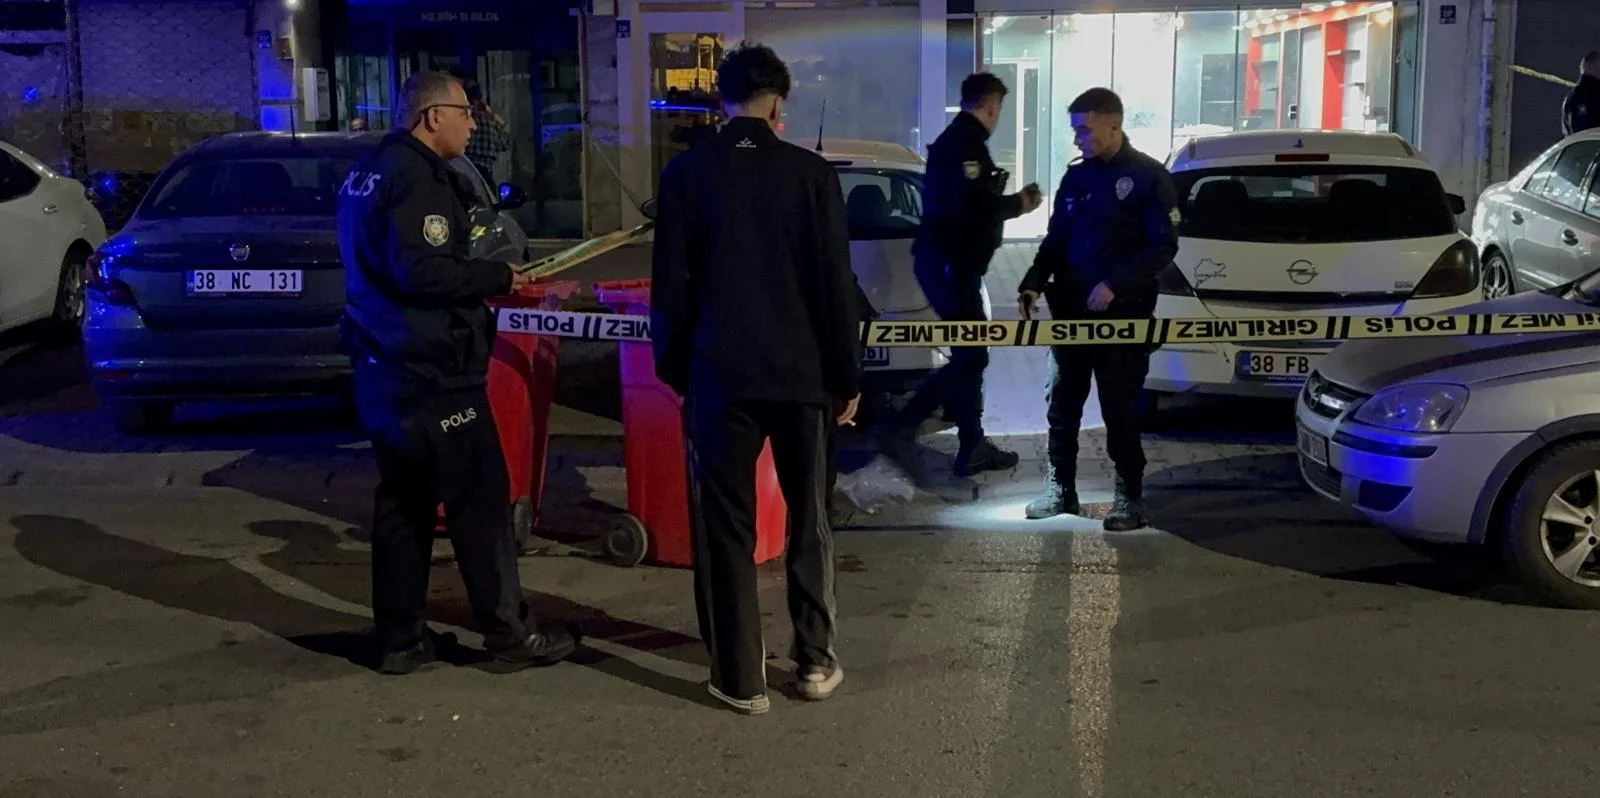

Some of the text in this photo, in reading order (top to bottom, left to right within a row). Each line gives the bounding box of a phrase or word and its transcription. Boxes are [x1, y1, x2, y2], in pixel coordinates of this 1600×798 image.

[196, 271, 296, 290] 38 NC 131
[1251, 355, 1309, 374] 38 FB
